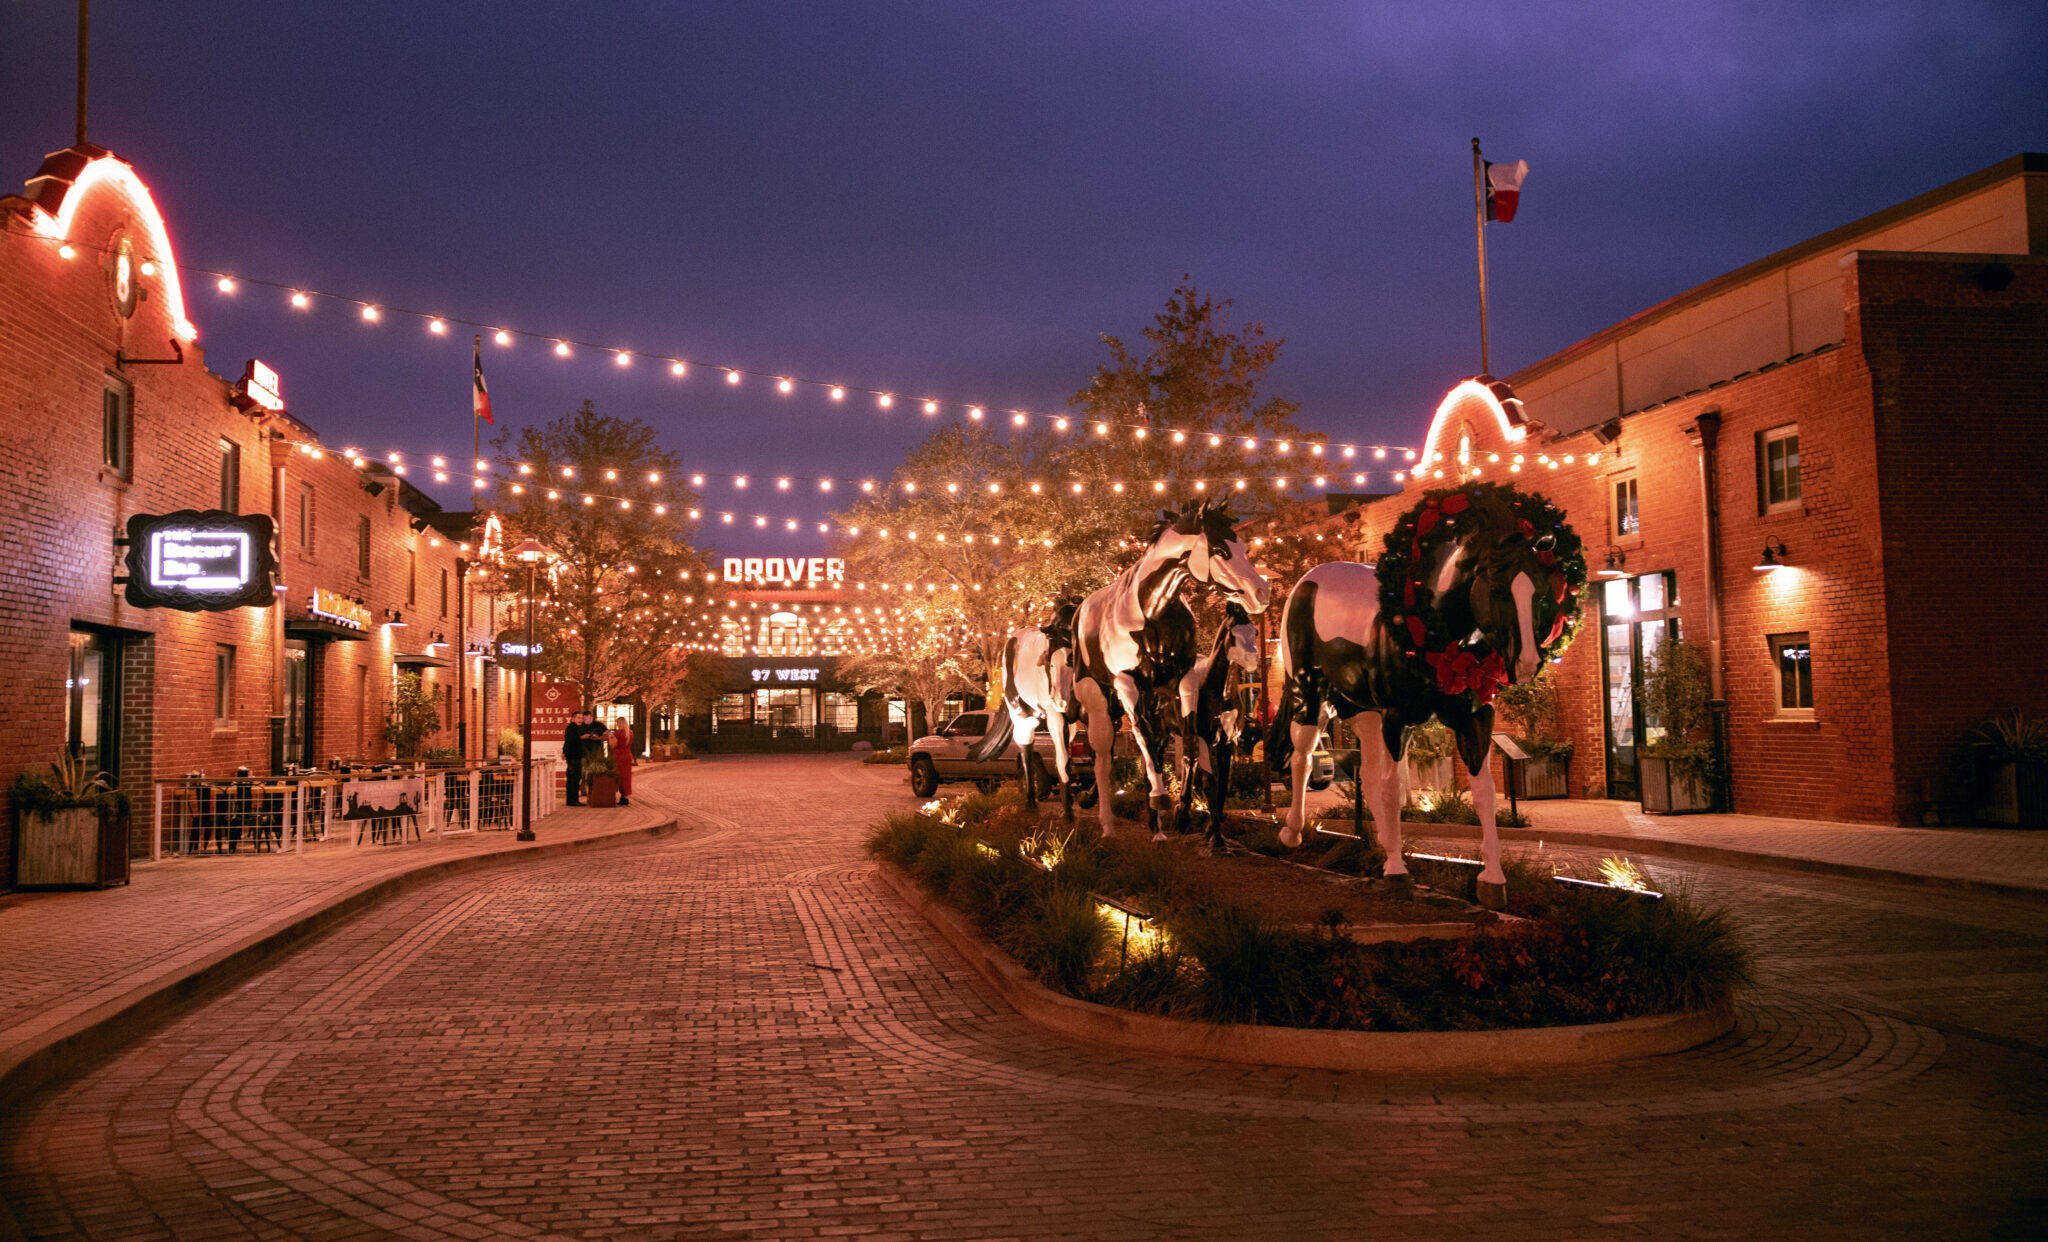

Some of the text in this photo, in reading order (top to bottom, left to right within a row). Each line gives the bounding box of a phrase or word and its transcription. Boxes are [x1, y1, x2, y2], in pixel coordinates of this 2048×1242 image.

[723, 557, 845, 582] DROVER
[751, 668, 820, 681] 97 WEST
[531, 716, 572, 724] ALLEY
